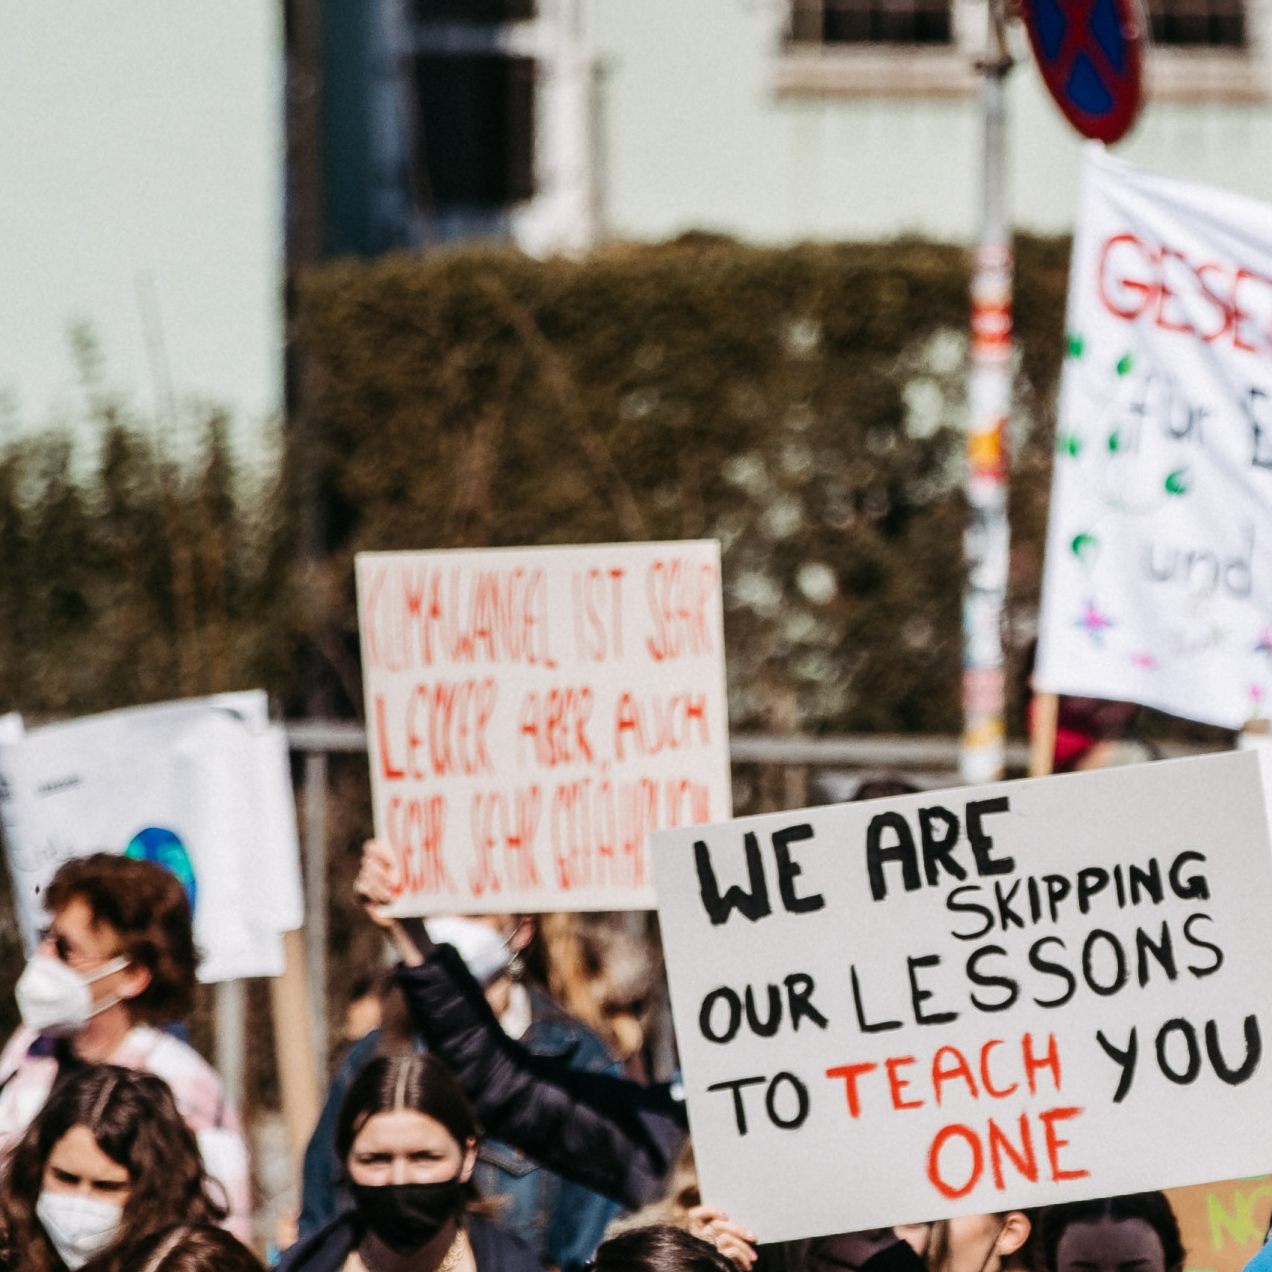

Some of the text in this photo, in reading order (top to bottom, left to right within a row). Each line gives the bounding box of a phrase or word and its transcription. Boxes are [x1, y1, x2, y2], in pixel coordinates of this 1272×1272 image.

[571, 564, 624, 663] IST
[645, 559, 715, 663] SEHR
[1148, 524, 1254, 598] und
[374, 677, 710, 781] LECKER ABER AUCH
[470, 783, 543, 896] SEHR
[693, 796, 1016, 926] WE ARE
[945, 850, 1212, 941] SKIPPING
[698, 913, 1225, 1045] OUR LESSONS
[706, 1013, 1262, 1137] TO TEACH YOU
[927, 1106, 1091, 1201] ONE
